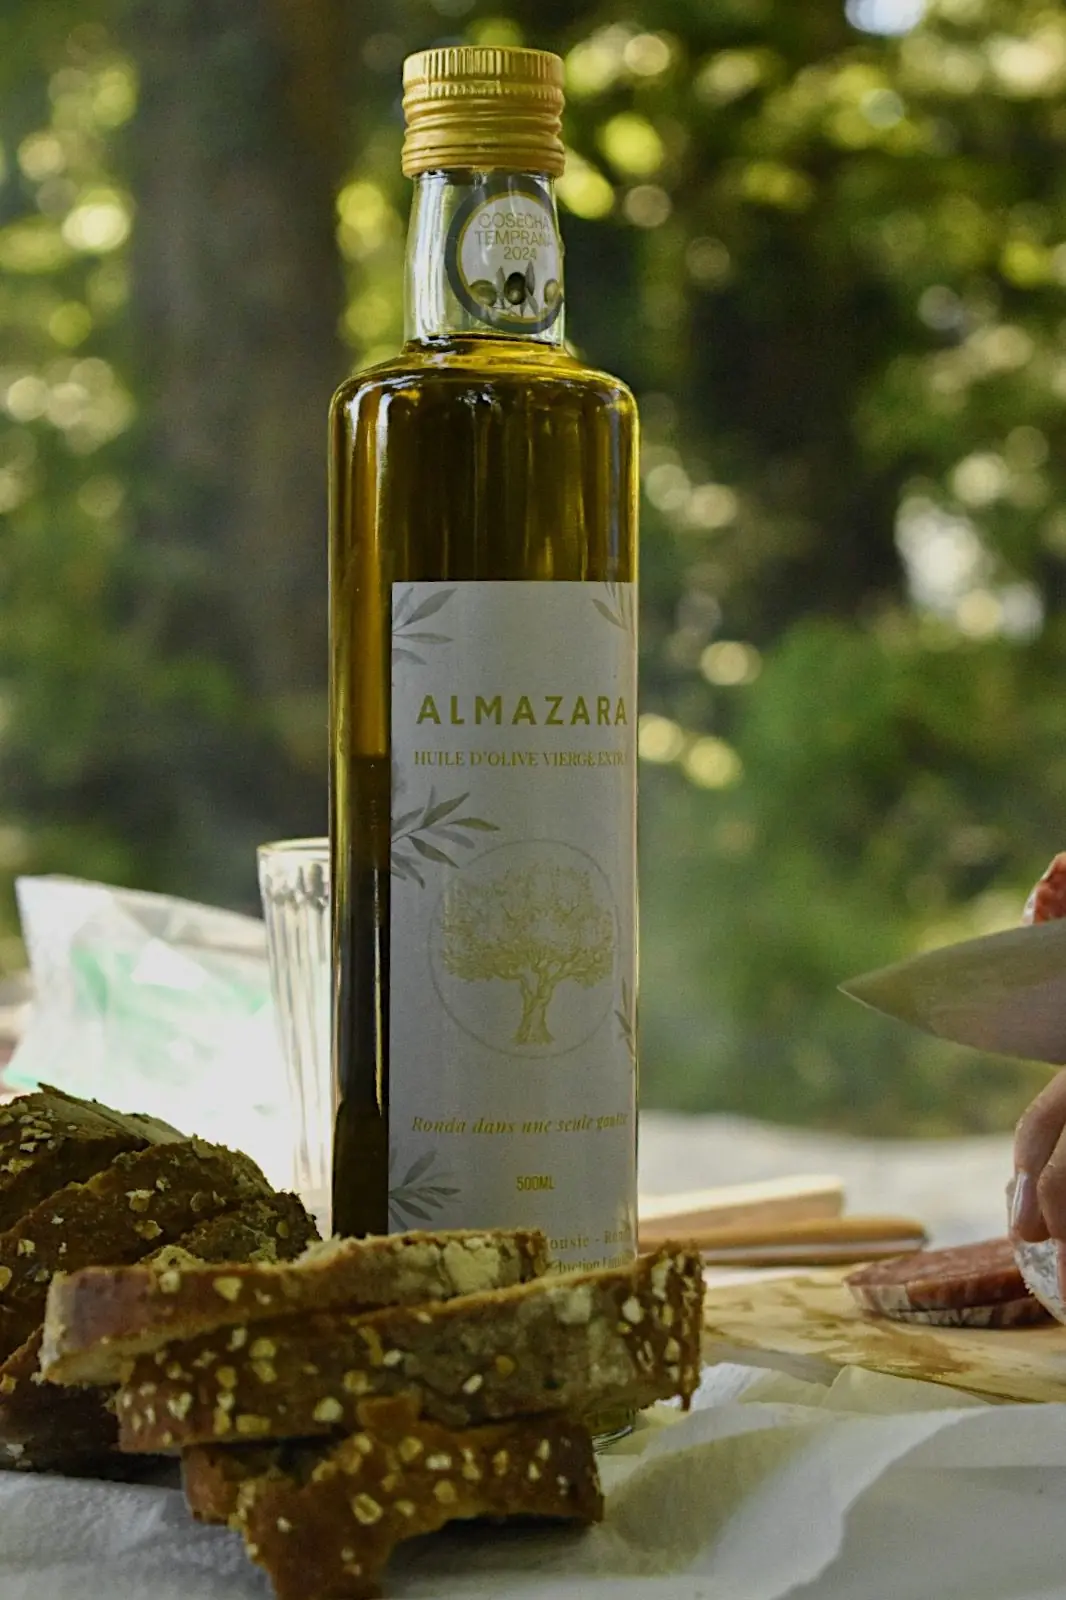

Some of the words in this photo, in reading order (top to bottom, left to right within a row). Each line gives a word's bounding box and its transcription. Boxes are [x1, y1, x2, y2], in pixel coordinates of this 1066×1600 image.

[477, 212, 550, 230] COSECHA
[503, 246, 537, 261] 2024
[416, 694, 628, 726] ALMAZARA
[414, 750, 465, 767] HUILE
[469, 750, 539, 767] D'OLIVE
[543, 751, 596, 767] VIERGE
[411, 1116, 467, 1134] Ronda
[471, 1116, 516, 1135] dans
[521, 1119, 551, 1134] une
[556, 1113, 594, 1133] seule
[515, 1174, 555, 1192] 500ML
